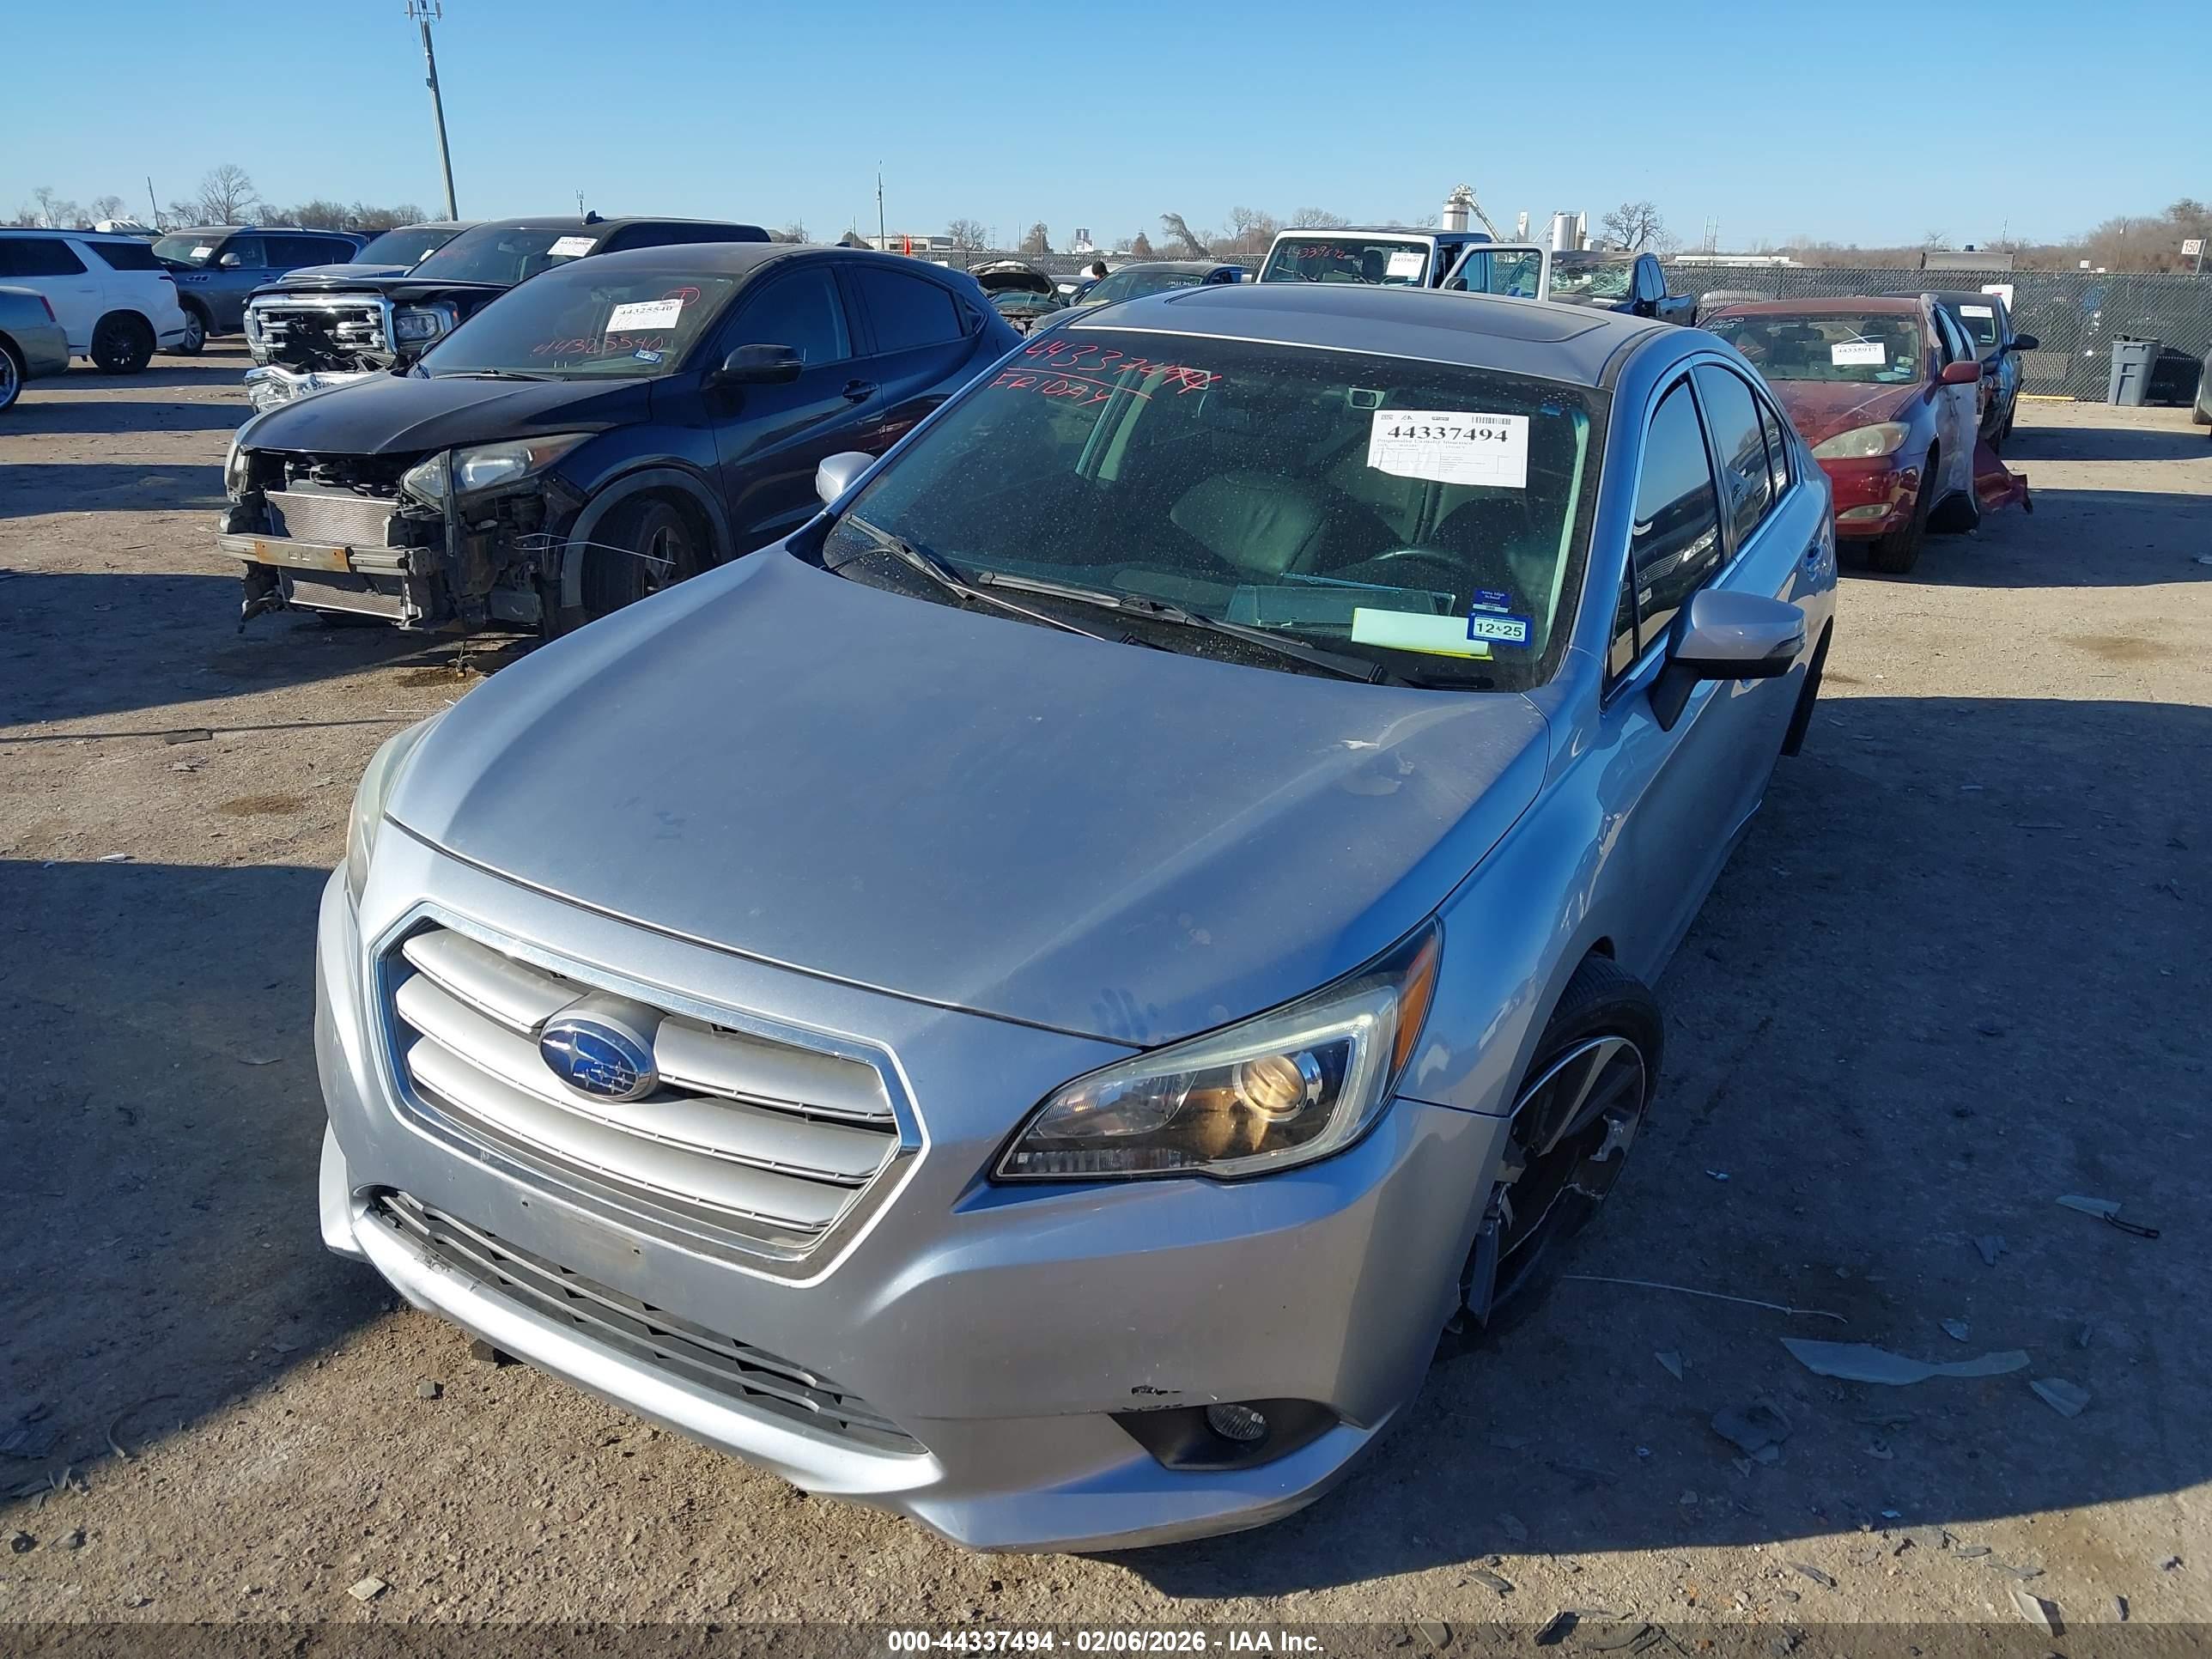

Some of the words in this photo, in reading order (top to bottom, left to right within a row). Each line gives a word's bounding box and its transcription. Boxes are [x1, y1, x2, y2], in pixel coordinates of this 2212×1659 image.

[2185, 241, 2199, 253] 150
[532, 336, 665, 355] 44325540
[988, 373, 1112, 406] FRIDAY
[1387, 425, 1509, 443] 44337494
[1476, 623, 1495, 634] 12
[1503, 625, 1522, 637] 25
